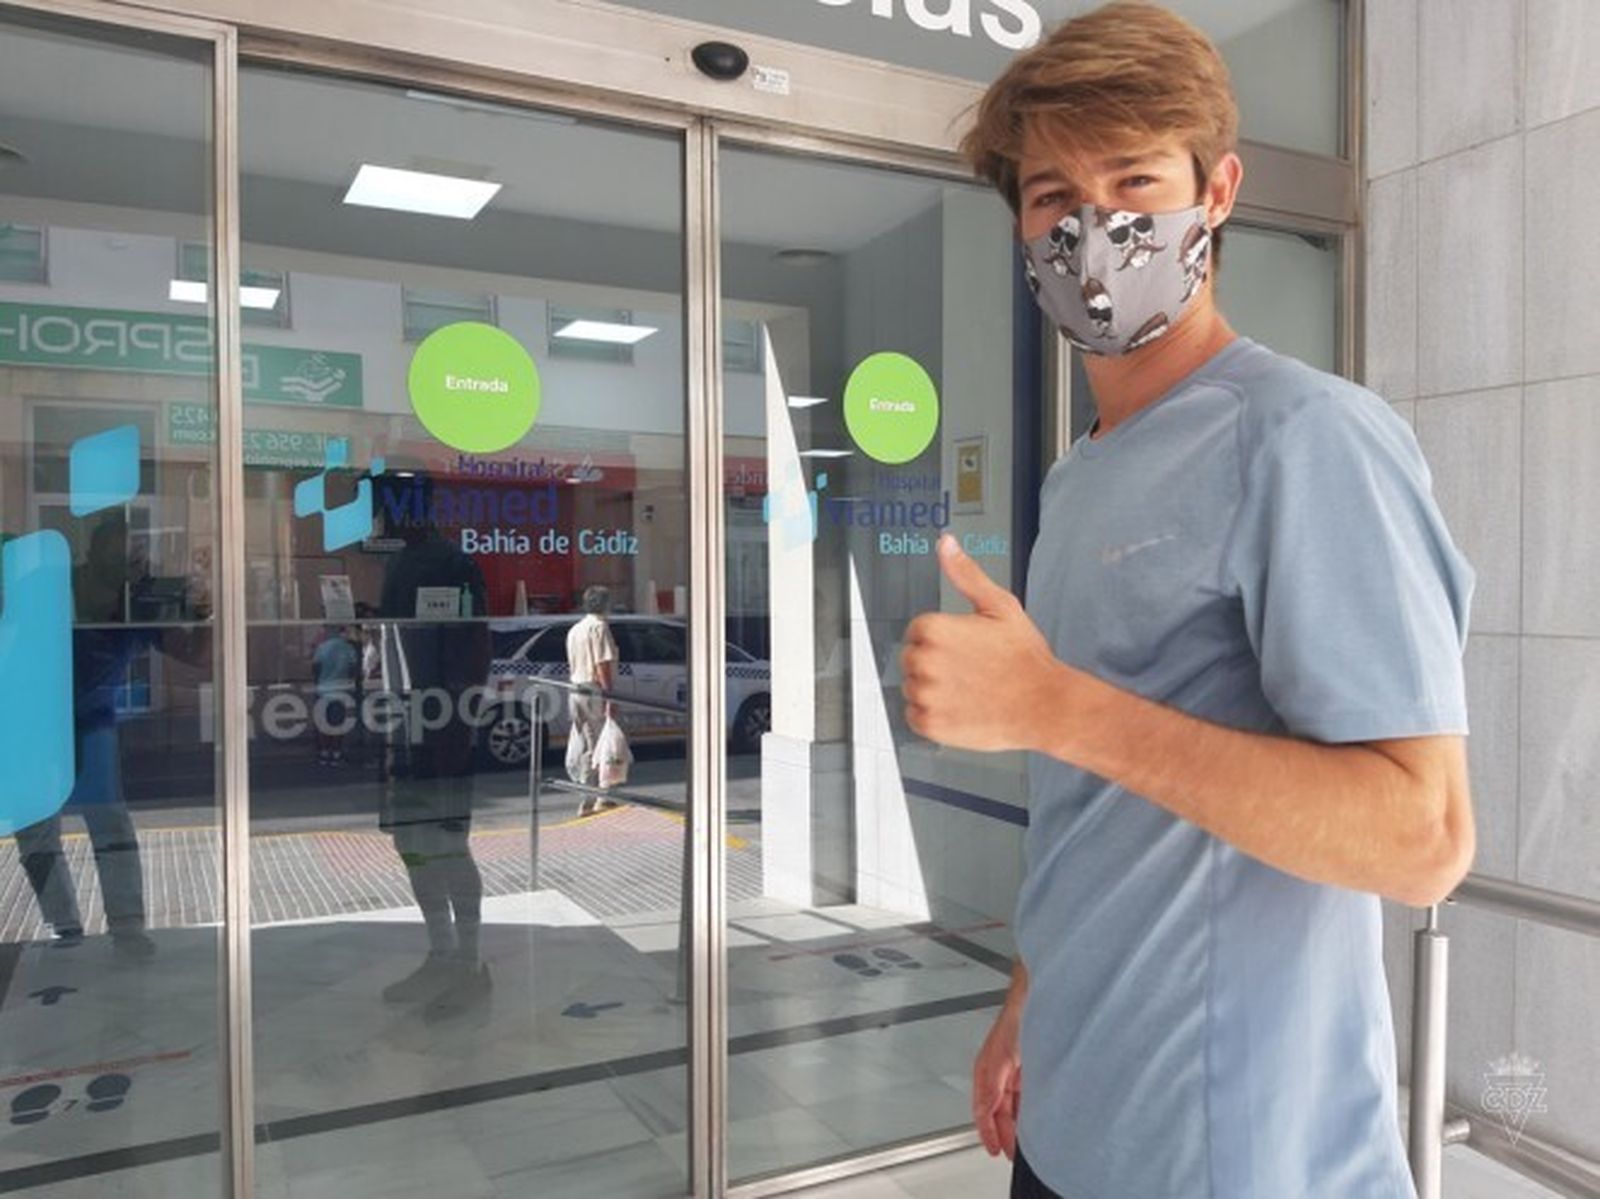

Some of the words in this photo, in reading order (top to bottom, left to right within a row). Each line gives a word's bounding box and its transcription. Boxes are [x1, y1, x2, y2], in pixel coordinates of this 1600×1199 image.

[445, 375, 509, 393] Entrada
[869, 397, 916, 413] Entrada
[460, 528, 531, 555] Bahía
[539, 529, 570, 555] de
[578, 529, 639, 556] Cádiz
